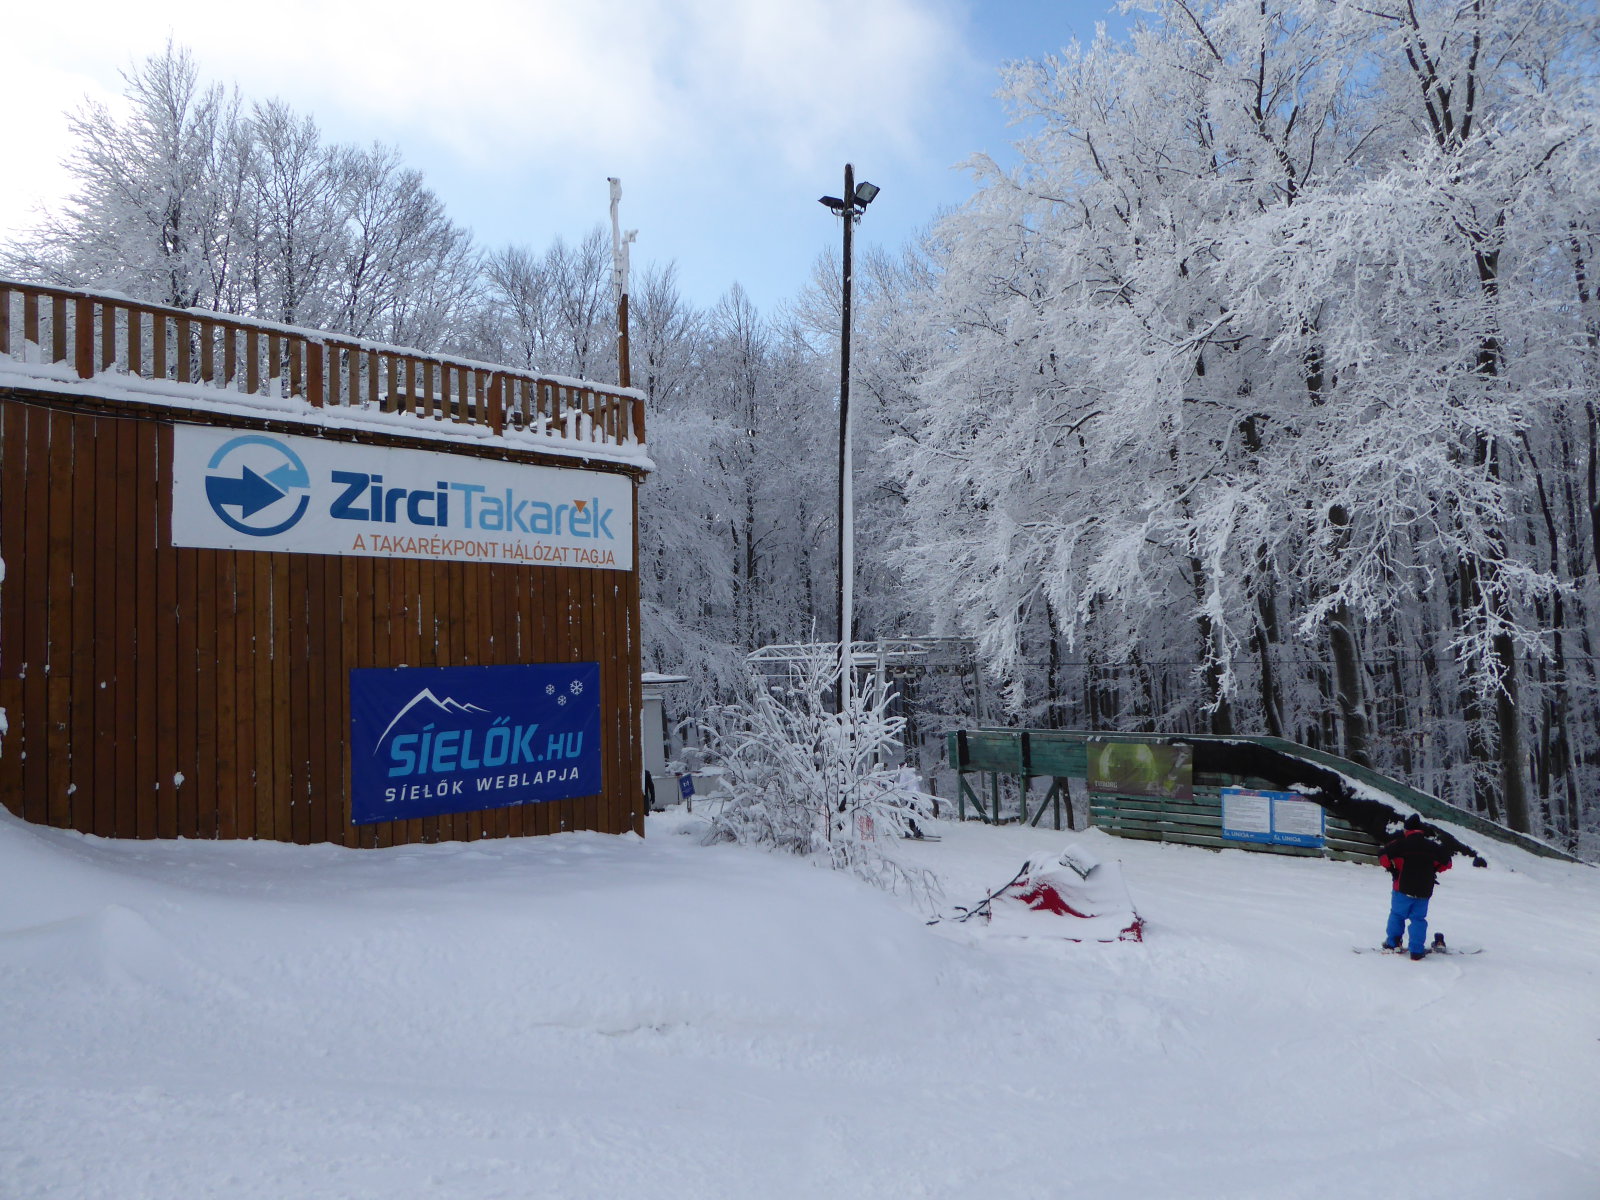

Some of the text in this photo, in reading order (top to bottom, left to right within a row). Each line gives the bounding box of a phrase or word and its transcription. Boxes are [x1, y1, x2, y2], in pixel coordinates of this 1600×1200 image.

[352, 532, 615, 566] A TAKARÉKPONT HÁLÓZAT TAGJA
[388, 716, 583, 777] SÍELŐK.HU
[384, 767, 579, 802] SÍELŐK WEBLAPJA
